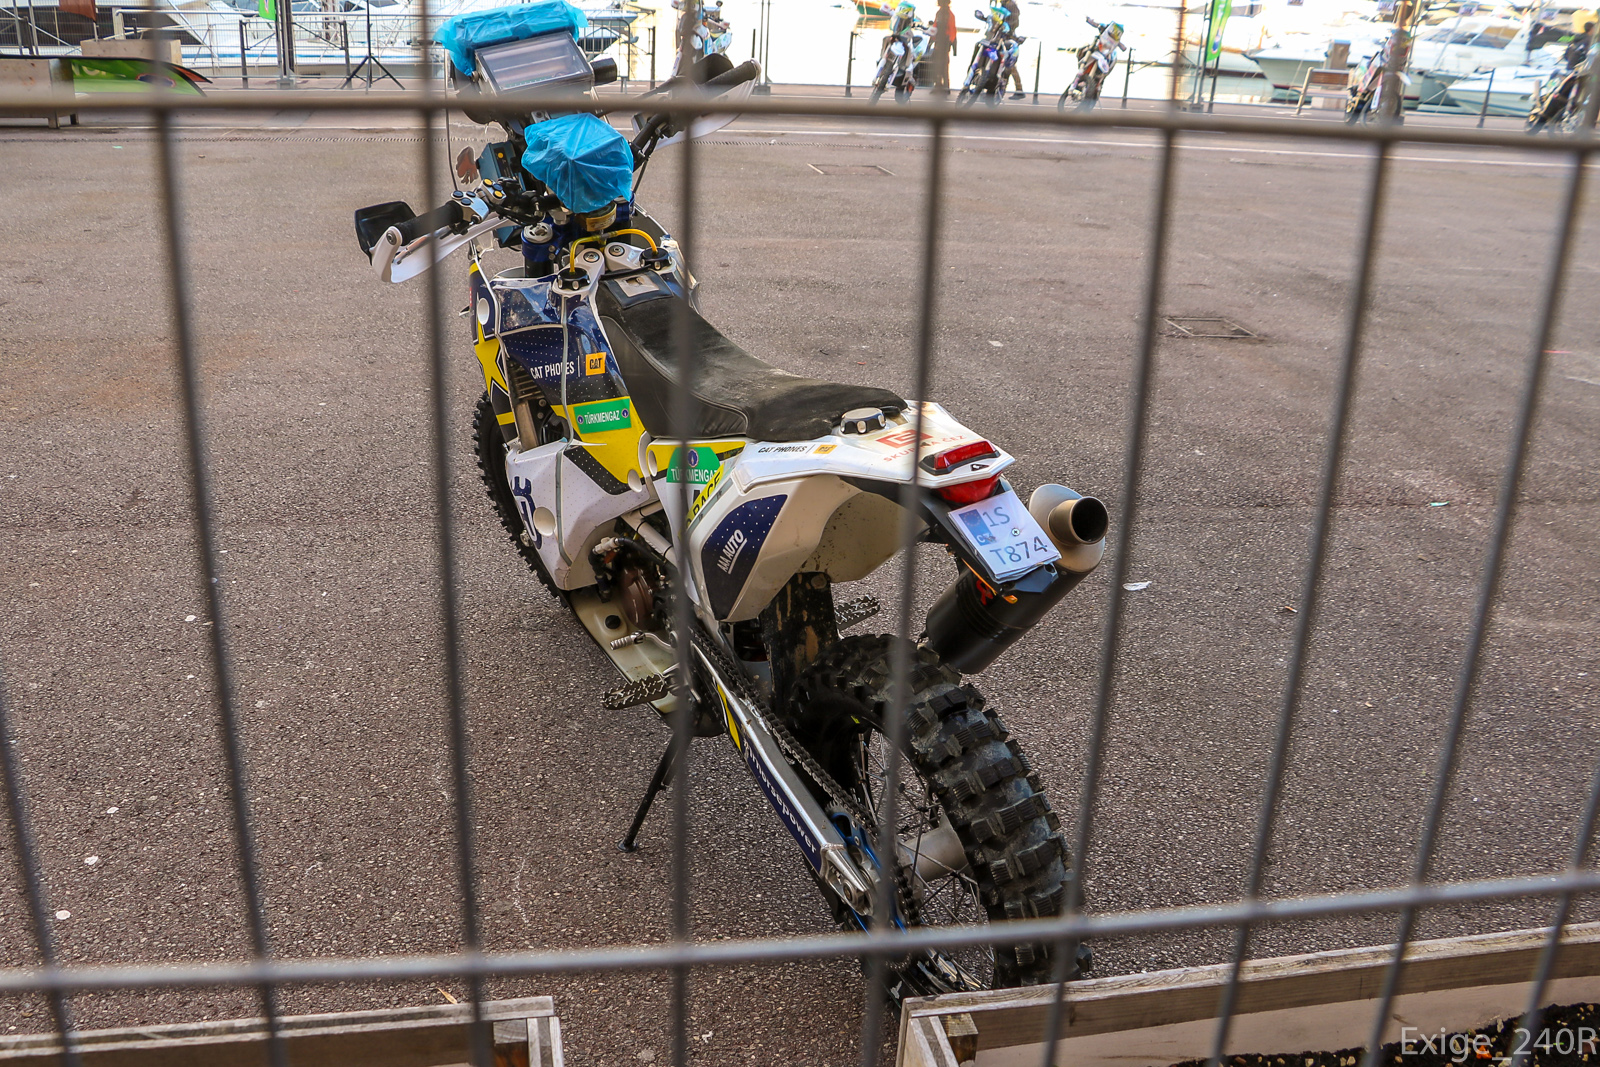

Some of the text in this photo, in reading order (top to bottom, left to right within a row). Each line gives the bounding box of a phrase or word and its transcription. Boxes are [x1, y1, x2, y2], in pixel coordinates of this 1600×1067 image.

[530, 358, 602, 379] CAT PHOES CAT
[584, 411, 620, 425] TÜRKMENGAZ
[883, 441, 941, 462] SKUPA
[982, 506, 1010, 527] 1S
[716, 529, 744, 573] AAA AUTO
[989, 536, 1048, 565] T874
